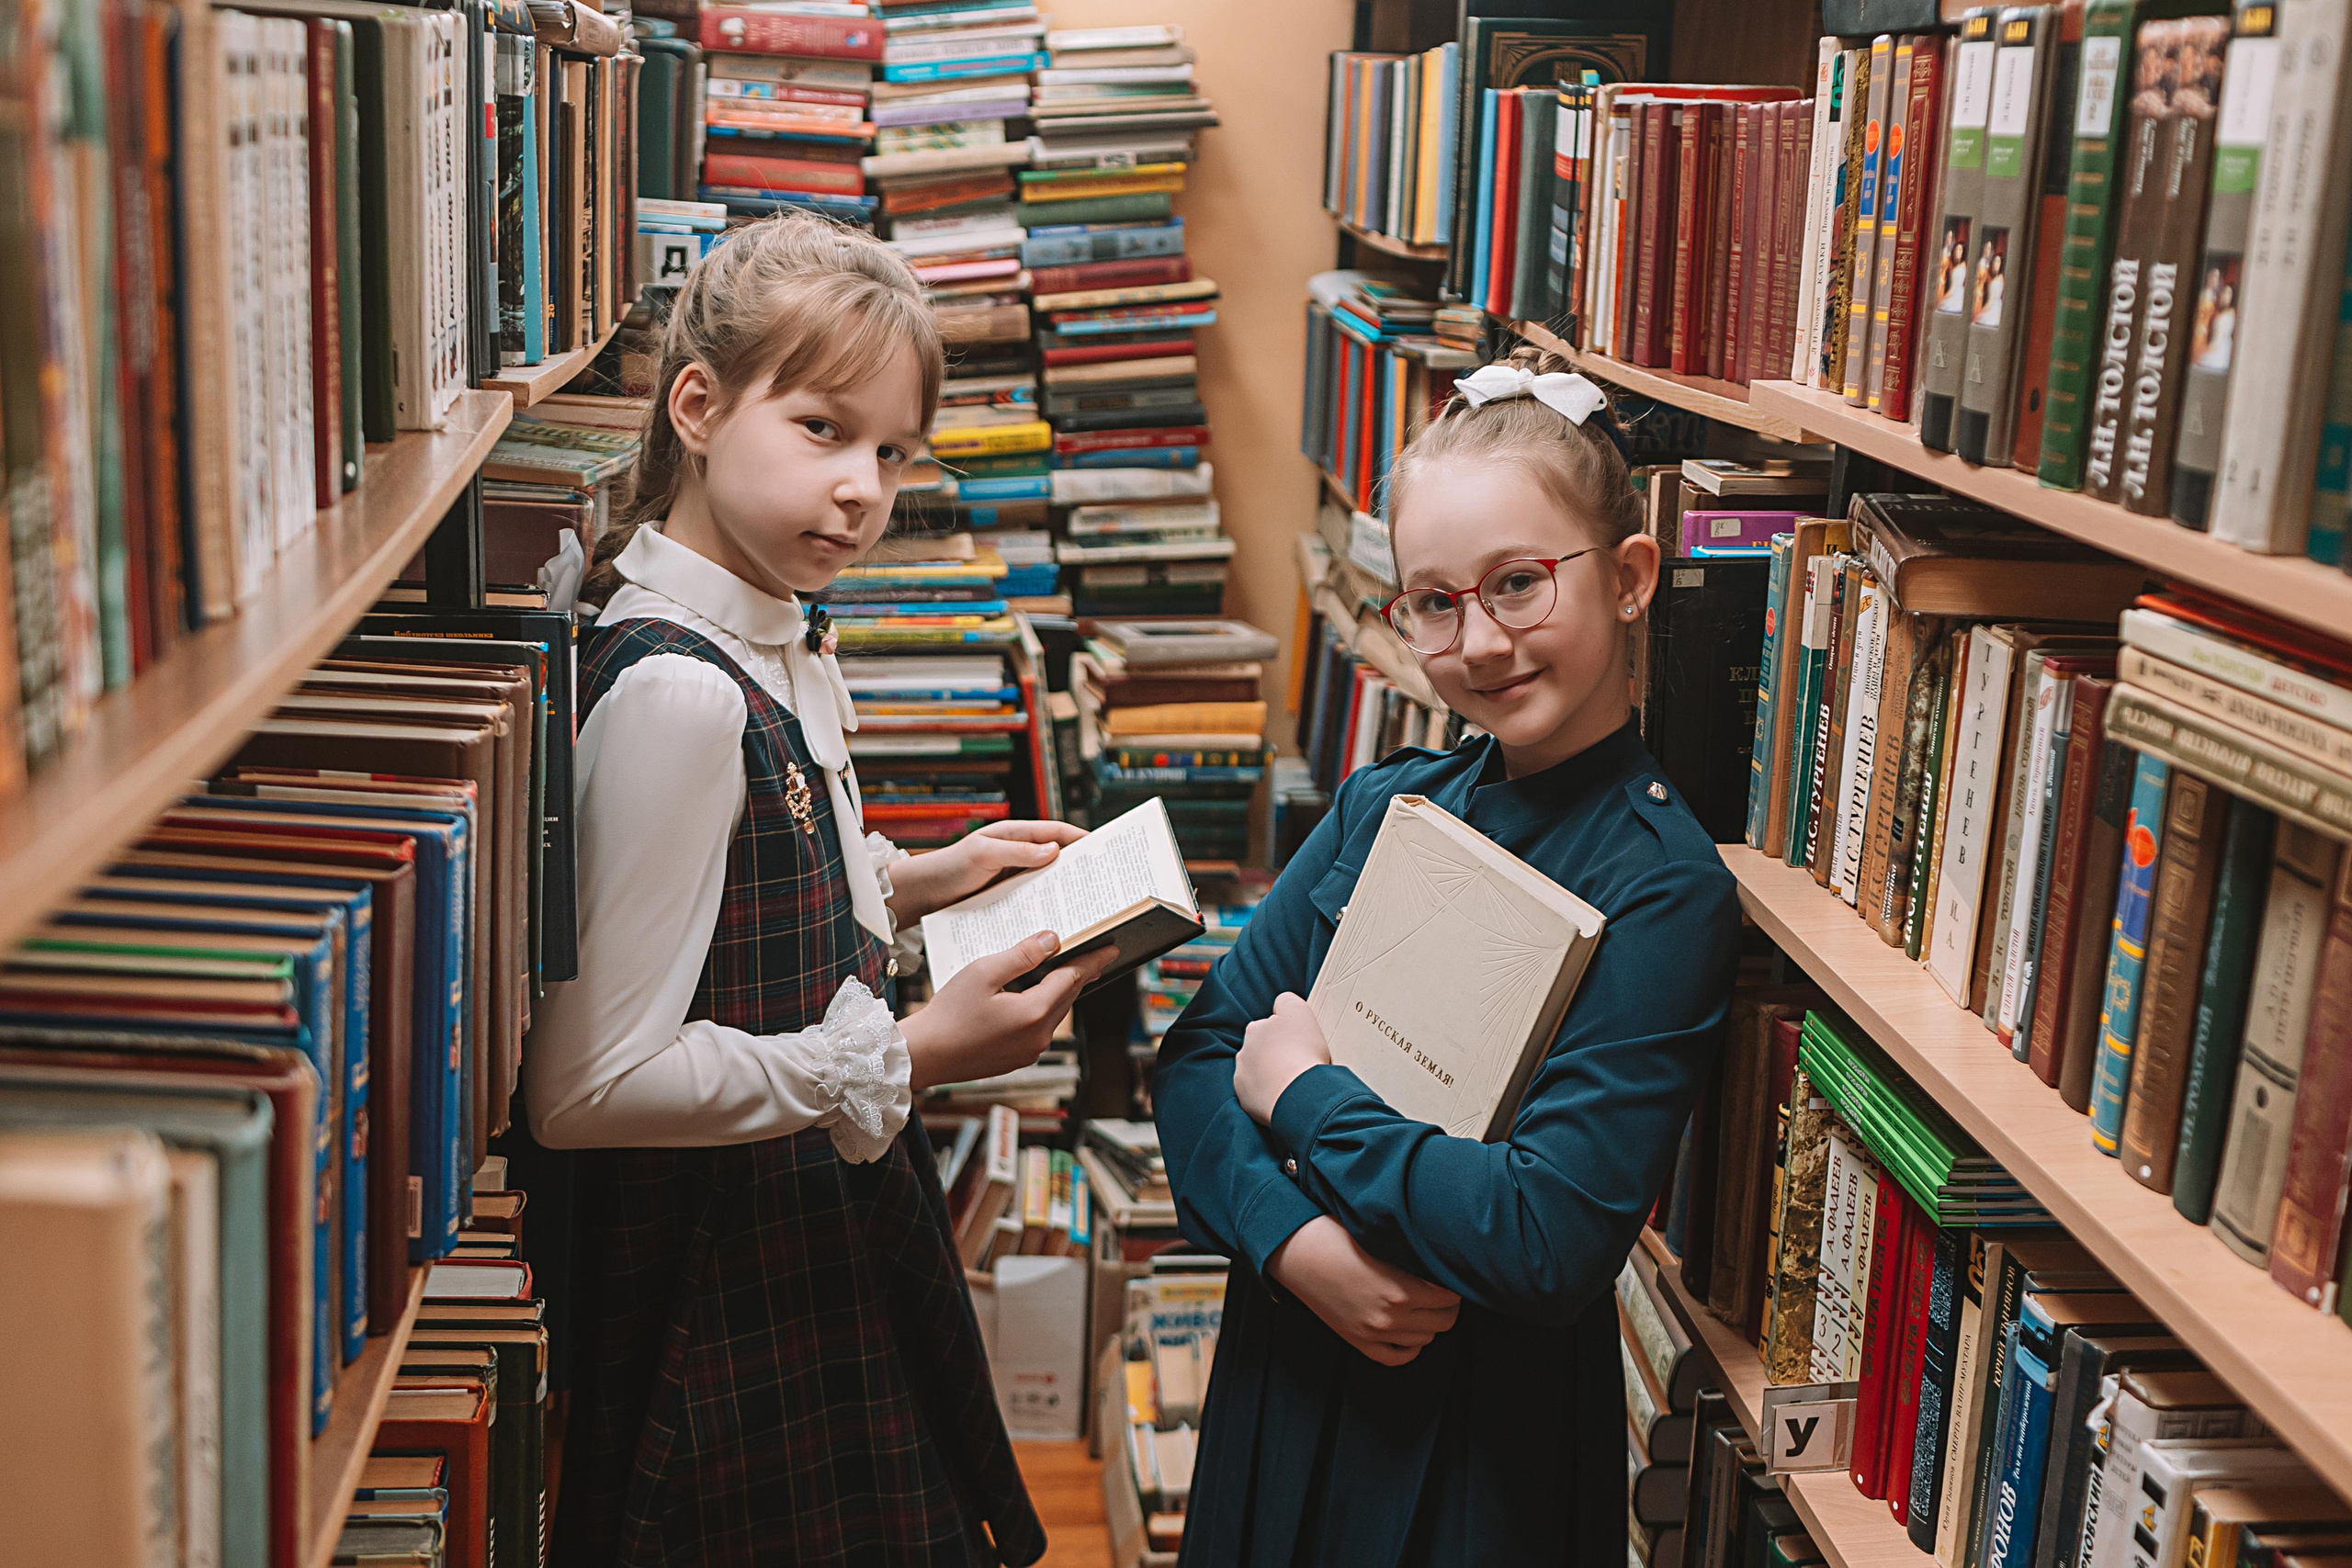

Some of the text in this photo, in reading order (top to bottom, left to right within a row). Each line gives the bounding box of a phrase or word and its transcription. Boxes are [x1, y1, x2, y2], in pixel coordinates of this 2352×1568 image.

[1826, 145, 1835, 186] рассказы
[1822, 194, 1831, 232] Повести
[661, 244, 690, 278] Д
[1817, 243, 1826, 284] КАЗАКИ
[2095, 258, 2140, 412] ТОЛСТОЙ
[2130, 263, 2177, 422] ТОЛСТОЙ
[393, 630, 445, 638] Библиотека
[1811, 703, 1830, 814] ТУРГЕНЕВ
[1848, 715, 1876, 838] ТУРГЕНЕВ
[1874, 734, 1901, 859] ТУРГЕНЕВ
[2001, 858, 2016, 920] ТОЛСТОЙ
[2014, 773, 2027, 820] КНЯЗЬ
[2023, 696, 2037, 769] СЕРЕБРЯНЫЙ
[1834, 813, 1843, 854] ТУРГЕНЕВ
[1912, 772, 1932, 891] ТУРГЕНЕВ
[2003, 727, 2046, 1018] АЛЕКСЕЙ ТОЛСТОЙ Князь Серебряный
[1355, 1000, 1455, 1089] О РУССКАЯ ЗЕМЛЯ!
[1829, 1156, 1842, 1232] ФАДЕЕВ
[1841, 1172, 1858, 1274] А. ФАДЕЕВ
[1857, 1193, 1872, 1294] А. ФАДЕЕВ
[1872, 1244, 1885, 1291] ТВЕН
[1910, 1269, 1926, 1317] ТВЕН
[1819, 1314, 1827, 1337] 3
[1831, 1333, 1841, 1358] 2
[1867, 1296, 1880, 1350] МАРК
[1994, 1341, 2007, 1389] ЮРИЙ
[2001, 1264, 2016, 1337] ТЫНЯНОВ
[1849, 1356, 1854, 1378] 1
[2018, 1380, 2032, 1443] набережной
[1951, 1421, 1962, 1461] СМЕРТЬ
[1946, 1466, 1955, 1504] Тынянов
[1942, 1506, 1951, 1532] Юрий
